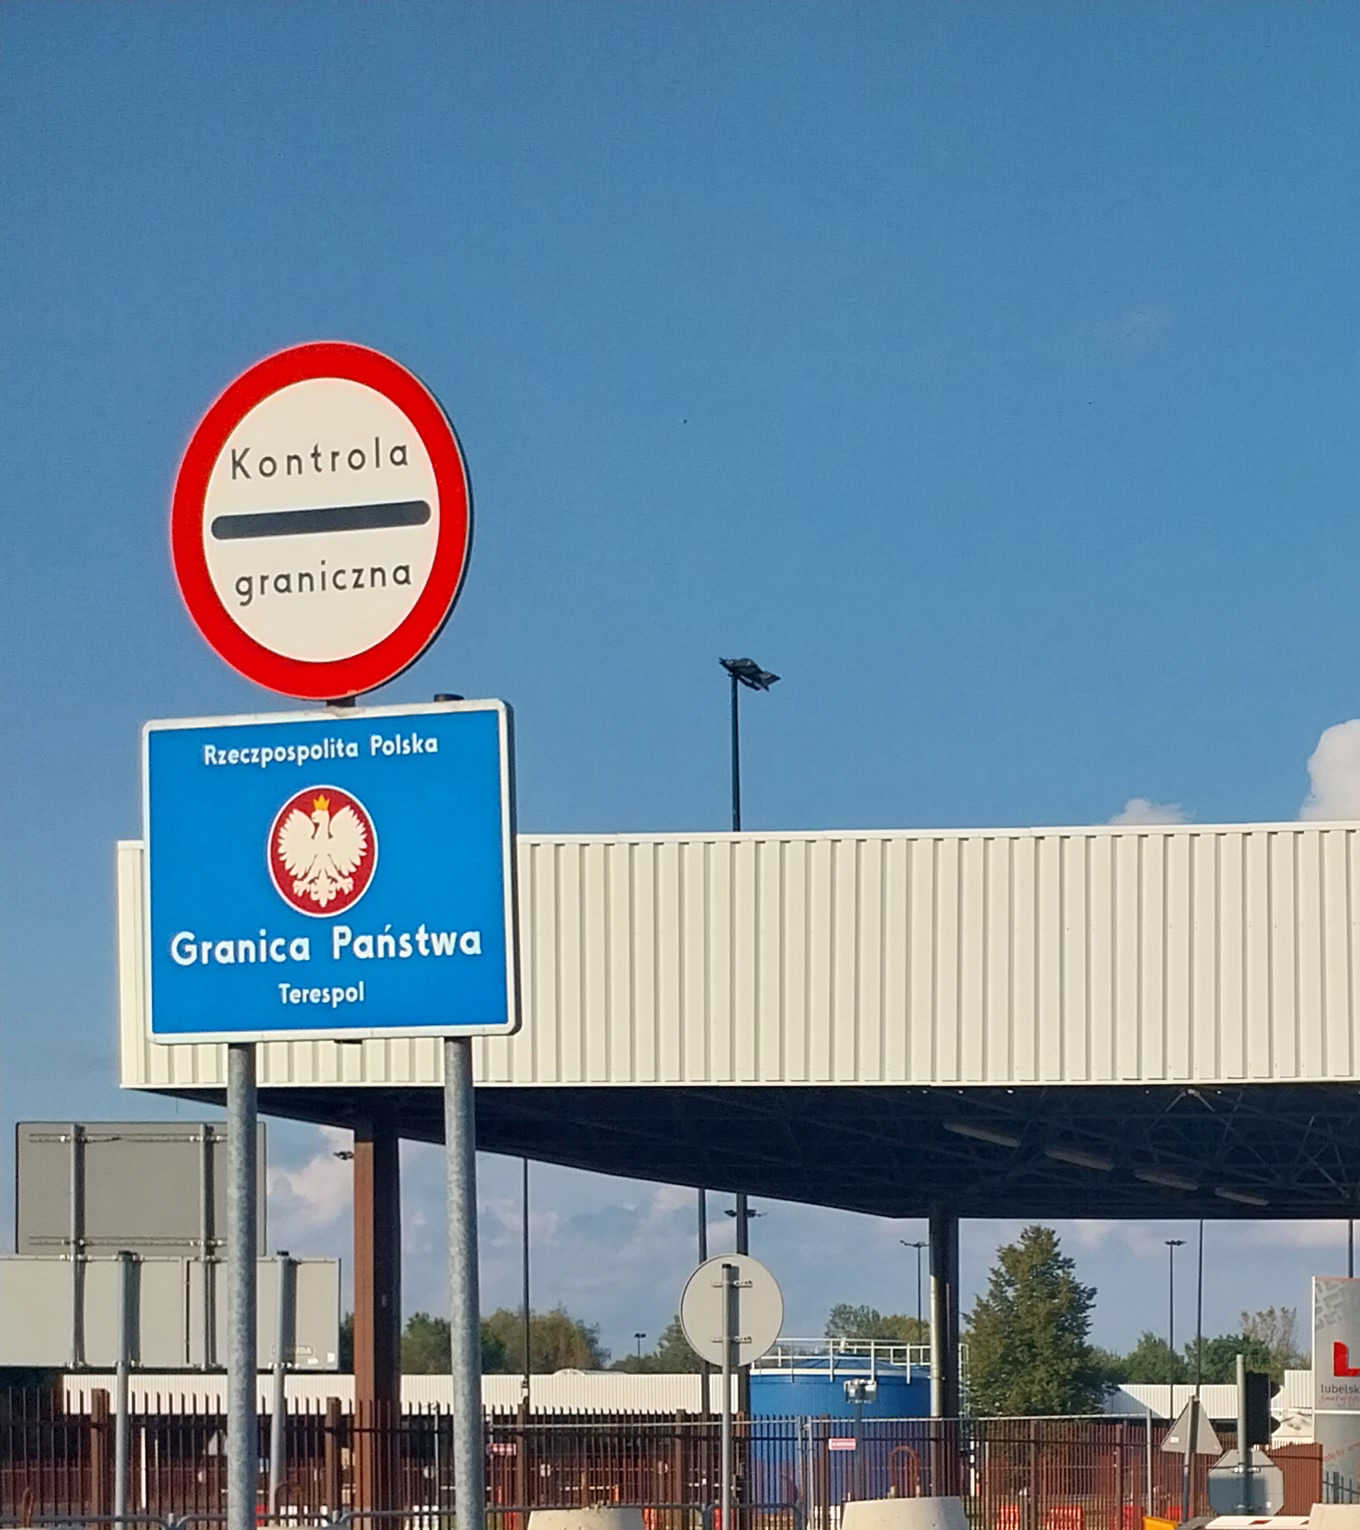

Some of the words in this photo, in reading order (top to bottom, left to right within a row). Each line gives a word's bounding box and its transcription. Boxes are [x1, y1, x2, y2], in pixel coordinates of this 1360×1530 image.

[230, 436, 408, 480] Kontrola
[235, 559, 412, 607] graniczna
[203, 737, 360, 768] Rzeczpospolita
[370, 732, 439, 757] Polska
[170, 928, 311, 967] Granica
[331, 923, 483, 961] Państwa
[278, 981, 365, 1008] Terespol
